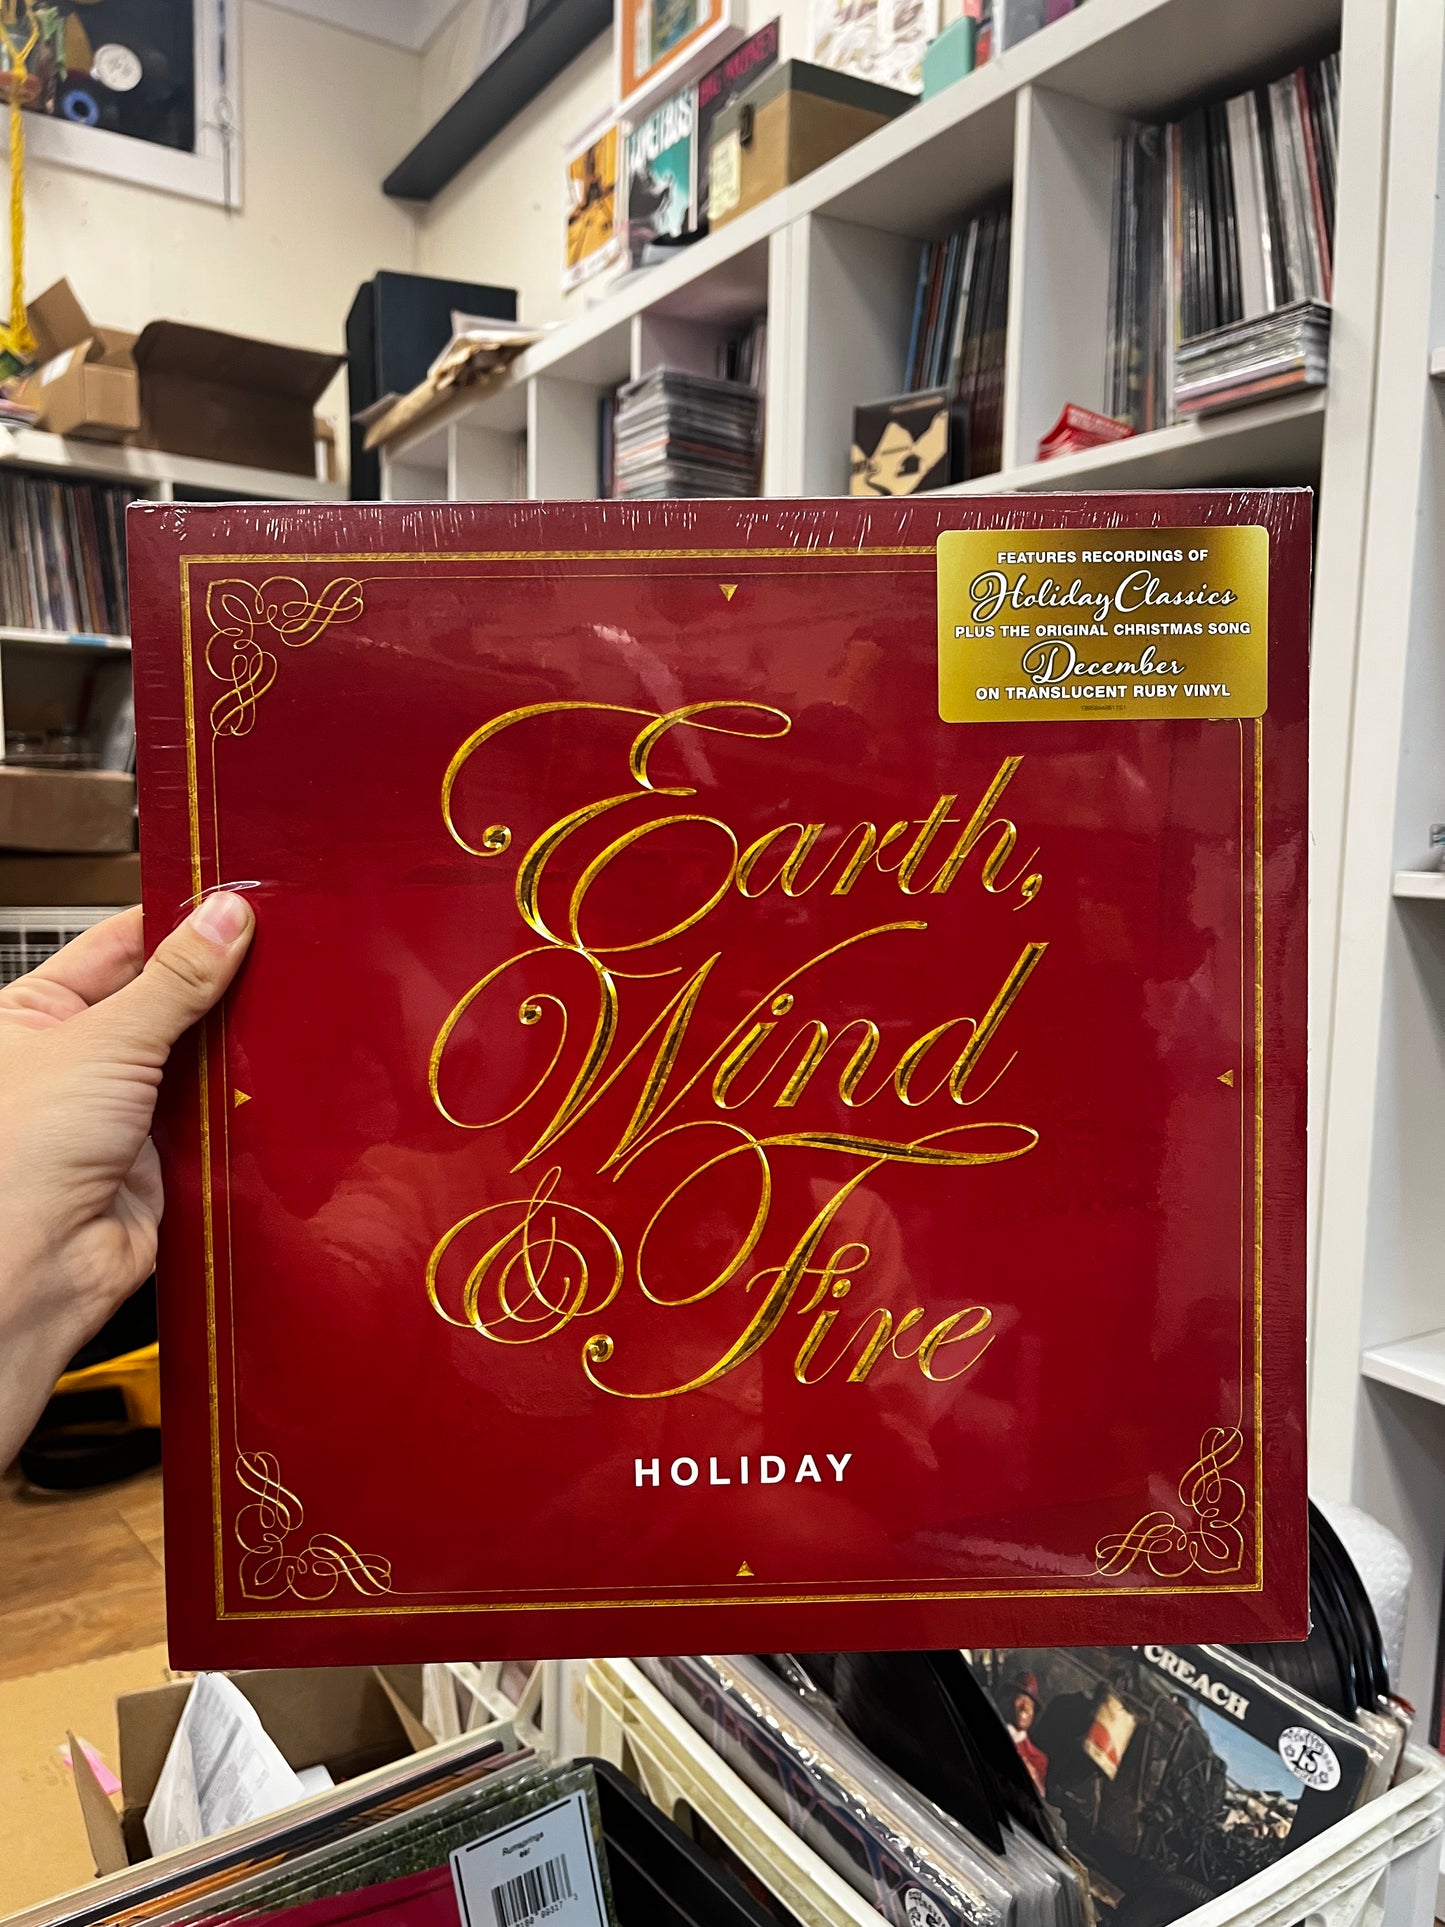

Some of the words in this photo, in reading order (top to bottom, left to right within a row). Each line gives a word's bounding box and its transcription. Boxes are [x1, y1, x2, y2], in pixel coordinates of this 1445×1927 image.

[998, 551, 1077, 564] FEATURES
[1081, 550, 1183, 563] RECORDINGS
[1188, 549, 1209, 562] OF
[970, 571, 1113, 622] Holiday
[1114, 569, 1236, 613] Classics
[955, 625, 995, 638] PLUS
[1000, 625, 1030, 637] THE
[1035, 624, 1109, 637] ORIGINAL
[1113, 623, 1203, 636] CHRISTMAS
[1208, 622, 1250, 635] SONG
[1023, 640, 1185, 684] December
[976, 687, 1000, 700] ON
[1005, 685, 1128, 699] TRANSLUCENT
[1133, 684, 1178, 698] RUBY
[1183, 684, 1231, 697] VINYL
[441, 701, 1043, 953] Earth,
[429, 921, 1049, 1174] Wind
[426, 1166, 624, 1344] &
[582, 1120, 1039, 1399] Fire
[635, 1453, 853, 1487] HOLIDAY
[1144, 1645, 1250, 1720] CREACH
